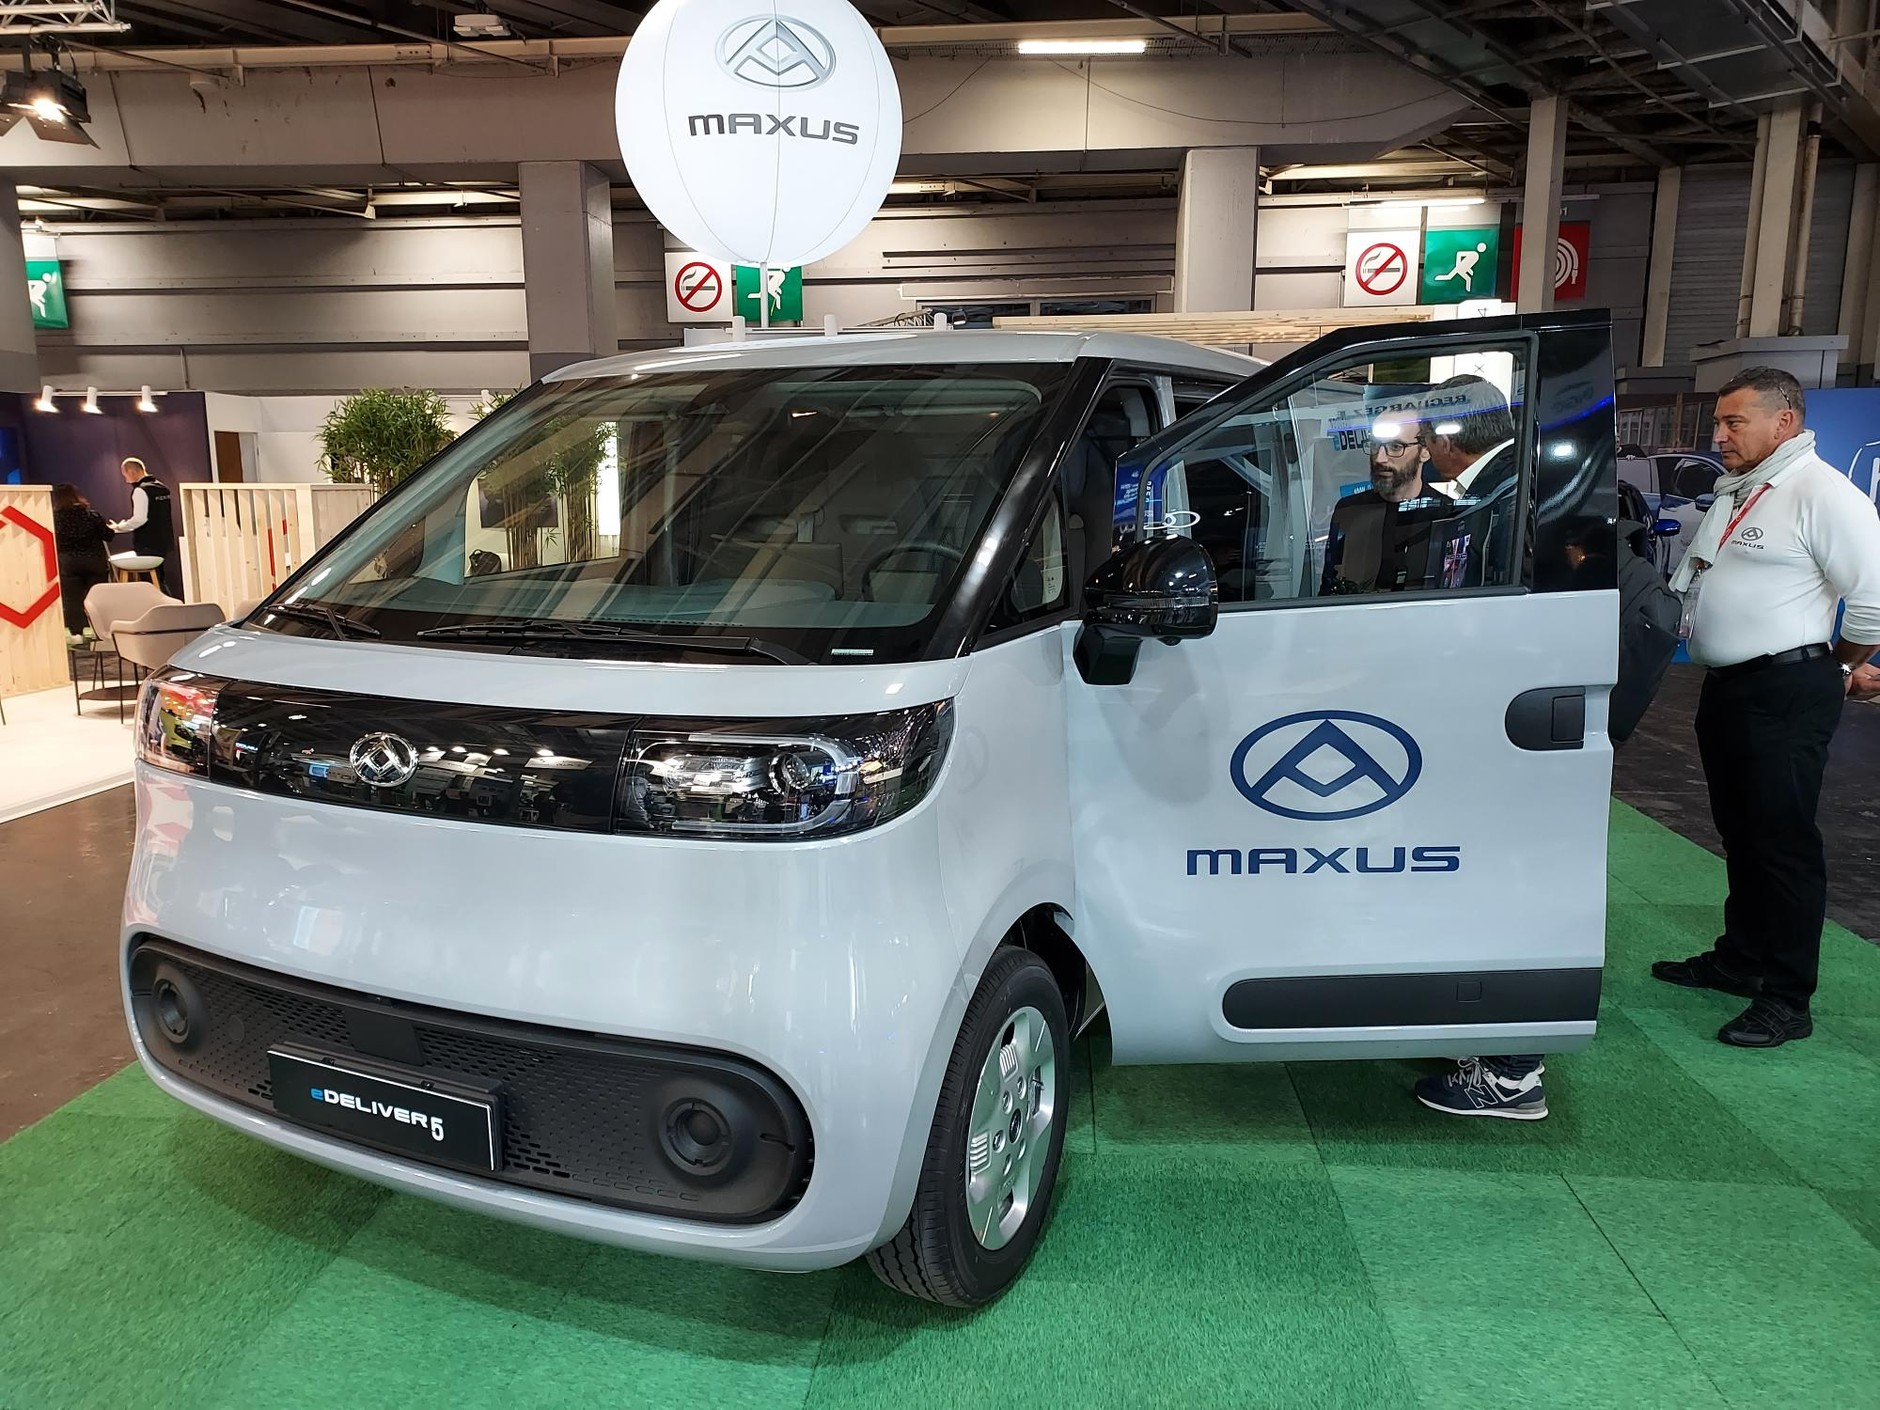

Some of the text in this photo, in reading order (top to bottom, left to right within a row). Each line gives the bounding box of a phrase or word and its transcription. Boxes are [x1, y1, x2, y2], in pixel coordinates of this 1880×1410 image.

[688, 113, 860, 145] MAXUS
[1731, 540, 1764, 549] MAXUS
[1186, 845, 1461, 875] MAXUS
